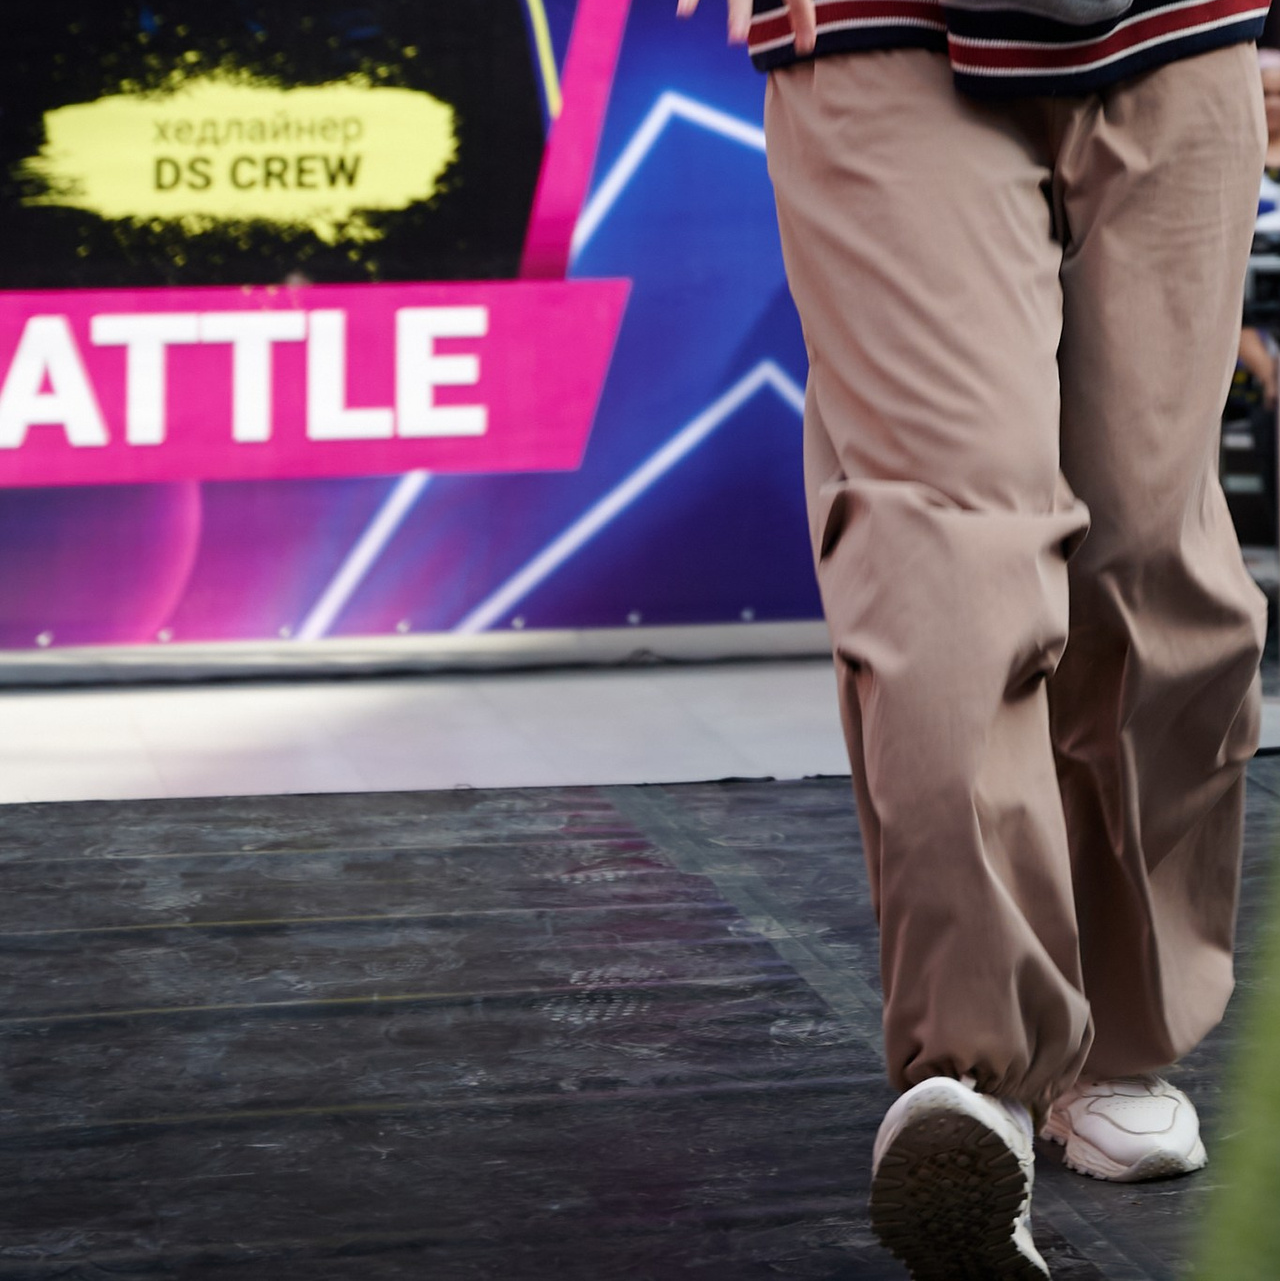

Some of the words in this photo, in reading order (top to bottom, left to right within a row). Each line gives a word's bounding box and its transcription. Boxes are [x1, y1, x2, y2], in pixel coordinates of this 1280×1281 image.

[153, 109, 363, 151] хедлайнер
[154, 155, 213, 191] DS
[229, 153, 362, 190] CREW
[0, 305, 488, 449] ATTLE
